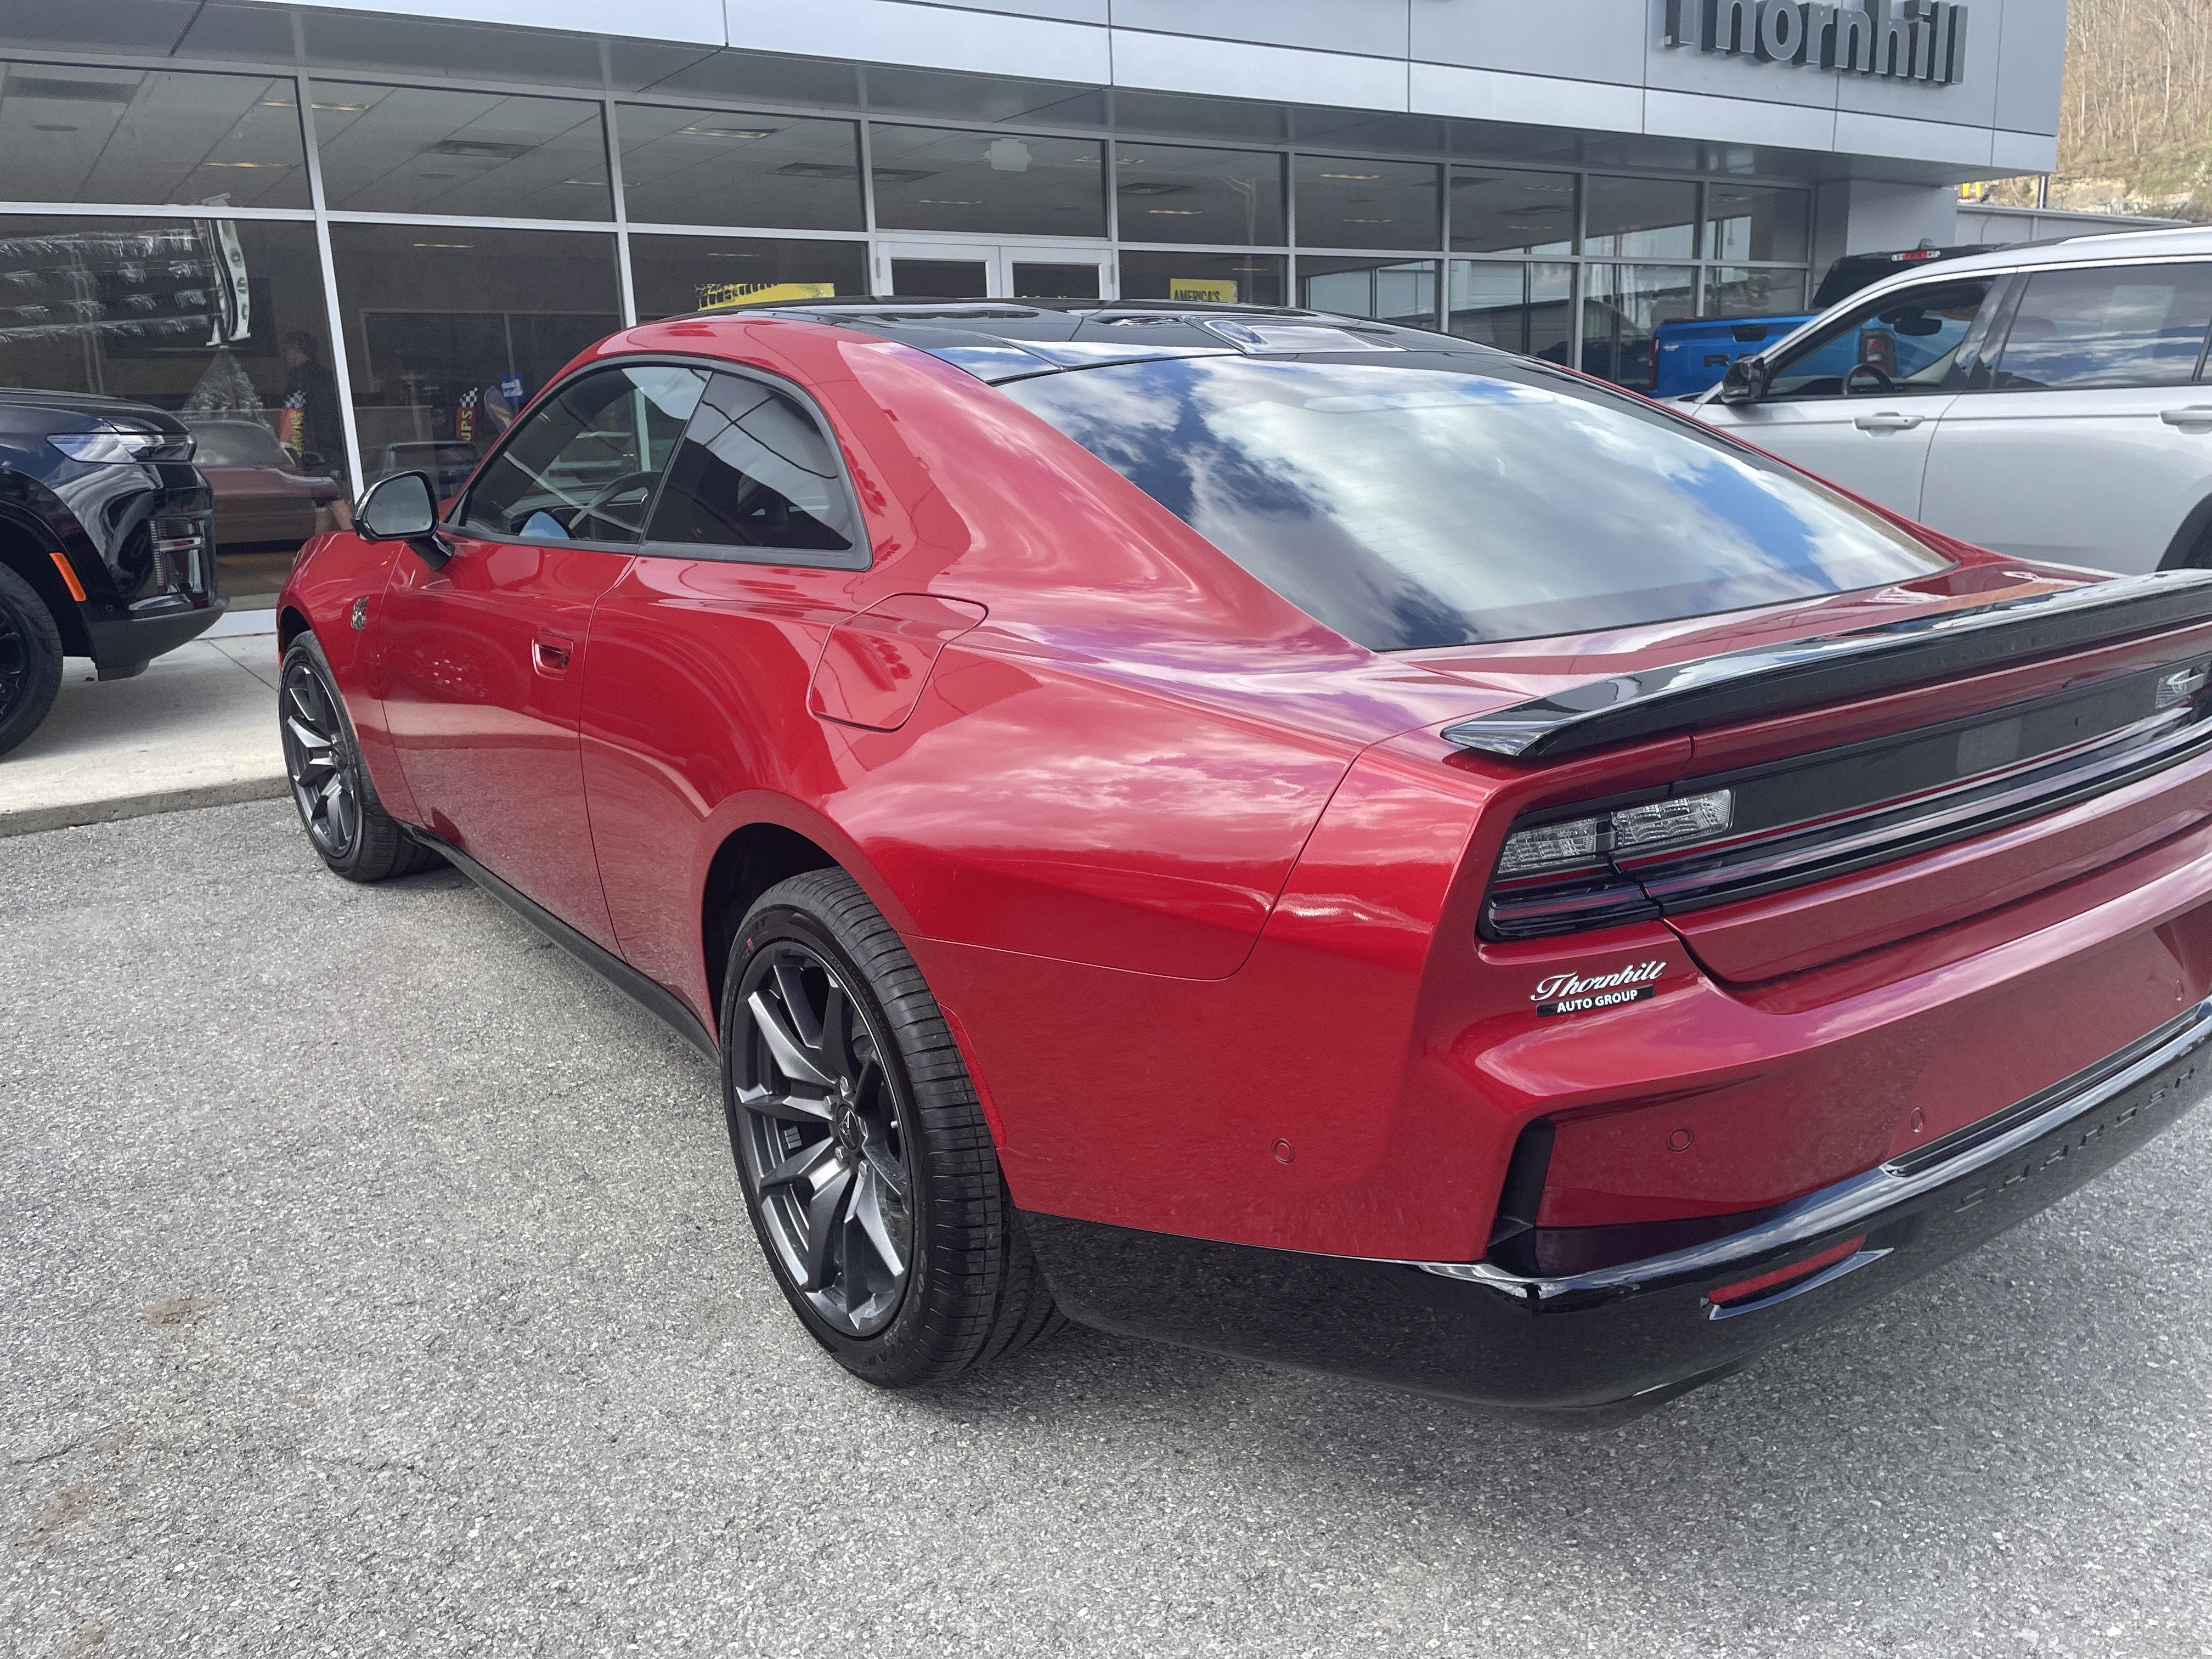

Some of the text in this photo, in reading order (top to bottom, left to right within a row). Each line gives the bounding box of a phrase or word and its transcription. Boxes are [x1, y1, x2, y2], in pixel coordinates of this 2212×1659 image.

[1530, 961, 1667, 1001] Thornhill
[1557, 990, 1638, 1013] AUTO GROUP
